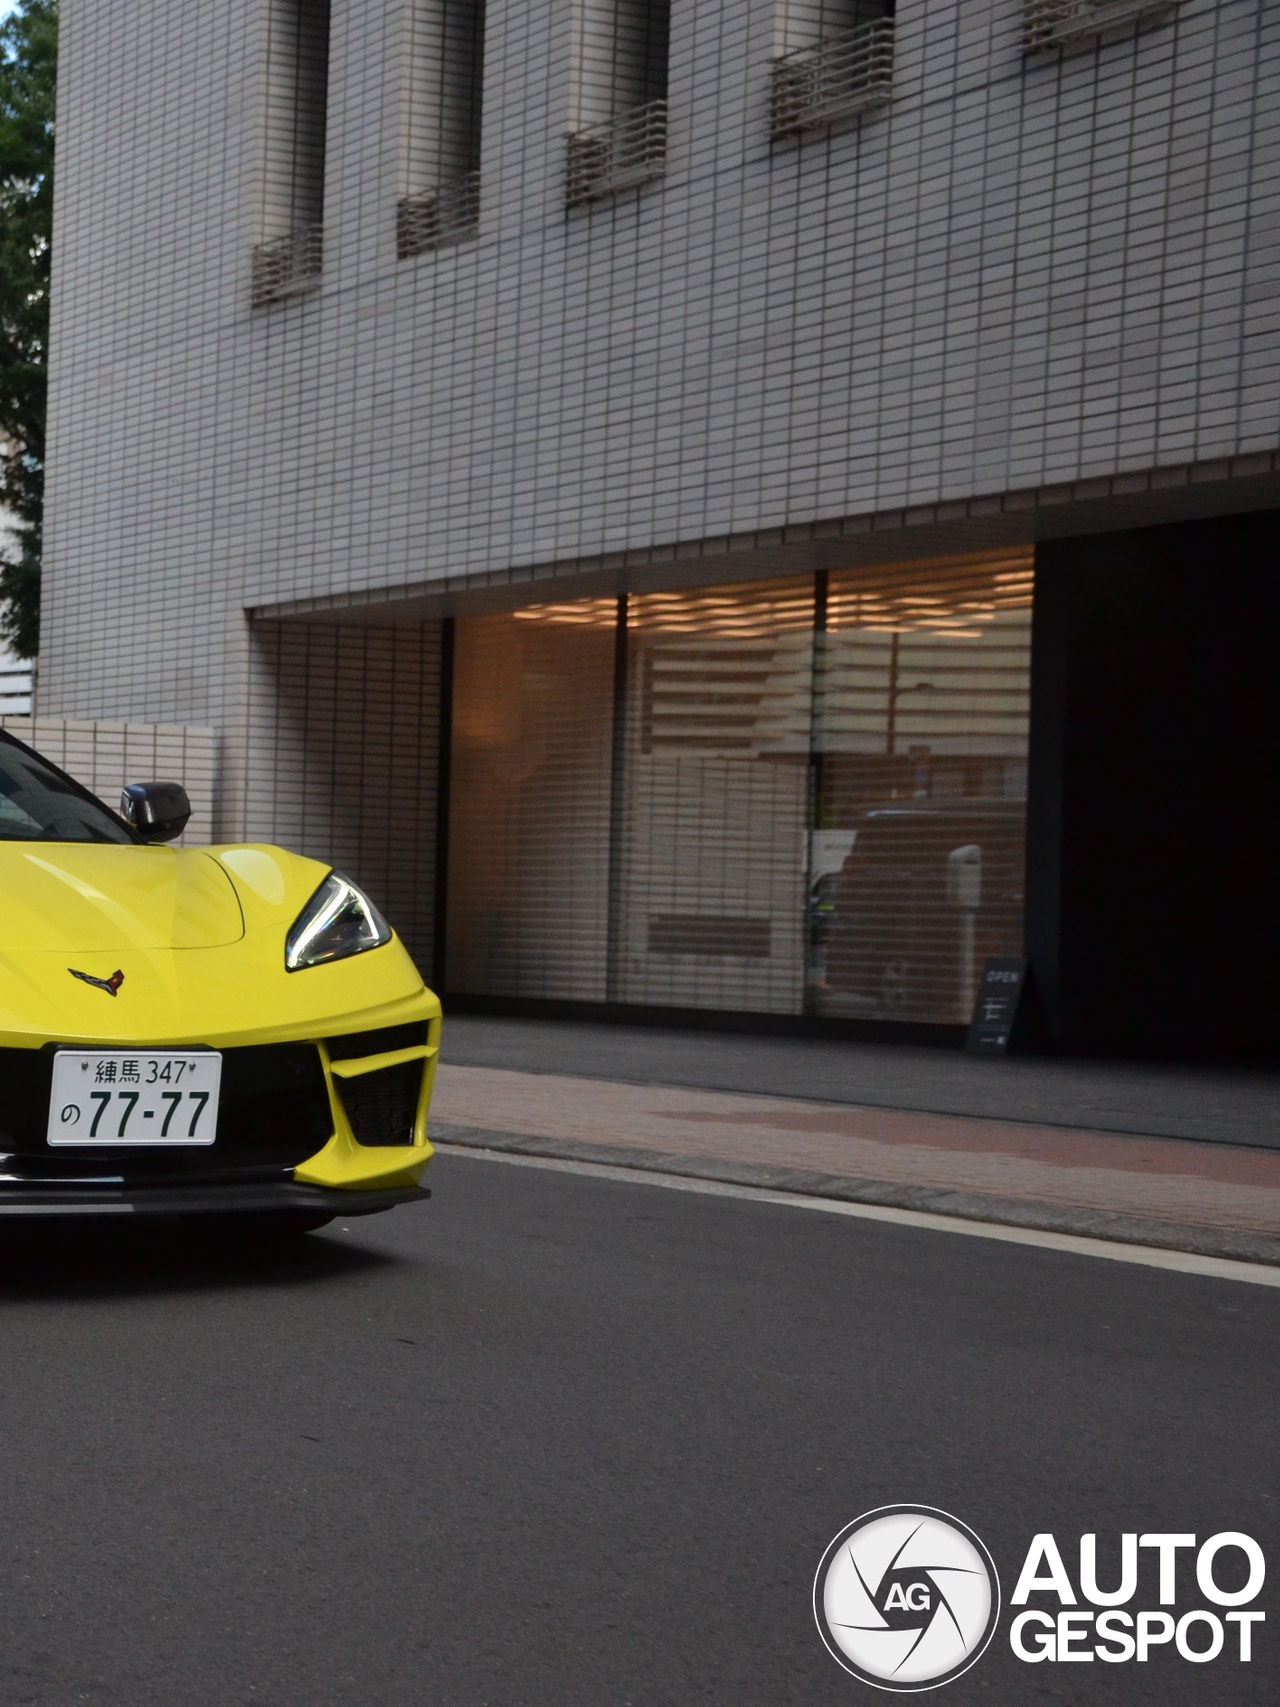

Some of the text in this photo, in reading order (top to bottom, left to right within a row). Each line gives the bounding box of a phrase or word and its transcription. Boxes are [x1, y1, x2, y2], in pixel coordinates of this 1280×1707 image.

[986, 970, 1018, 983] OPEN
[94, 1059, 187, 1084] 練馬 347
[61, 1091, 210, 1137] の 77-77
